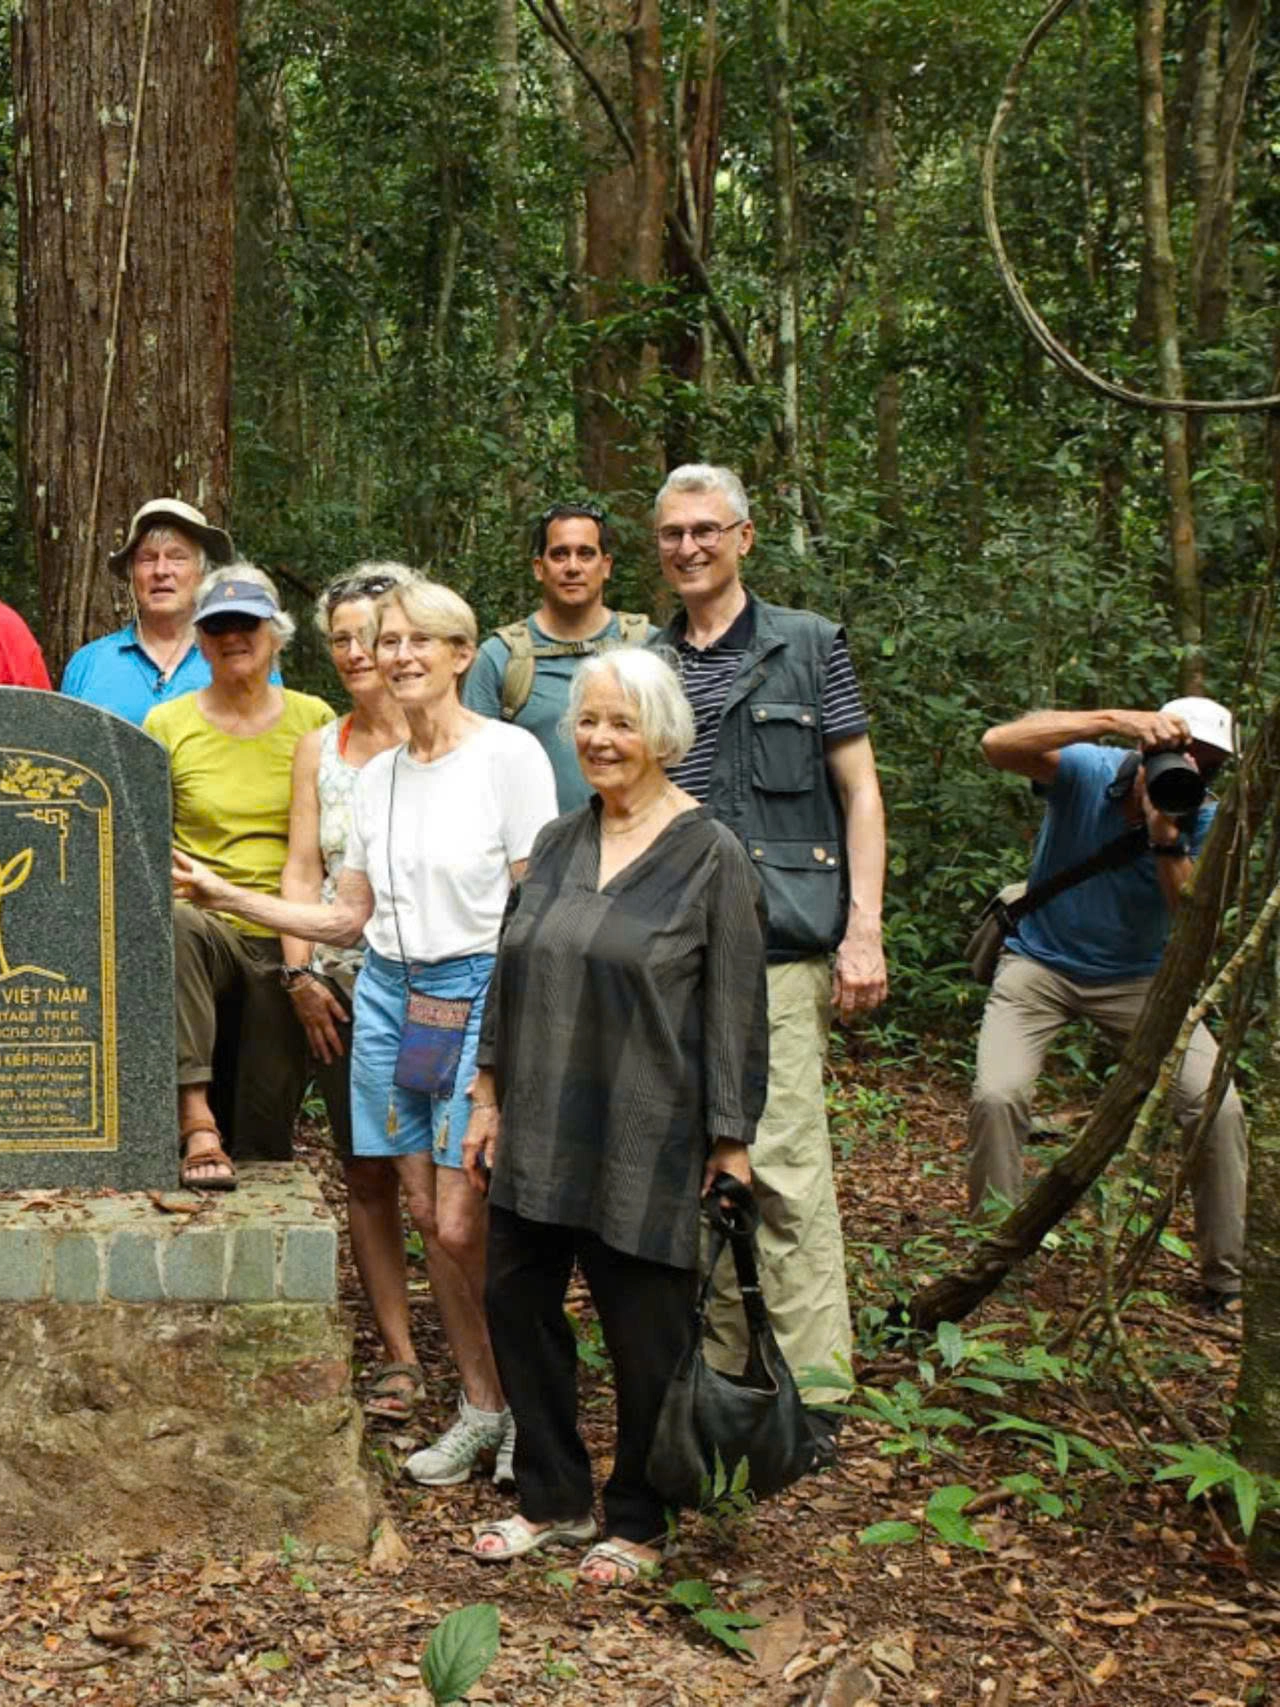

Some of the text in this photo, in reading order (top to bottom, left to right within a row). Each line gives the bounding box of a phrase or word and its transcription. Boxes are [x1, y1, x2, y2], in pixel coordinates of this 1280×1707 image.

[2, 985, 42, 1008] VIỆT
[48, 987, 89, 1004] NAM
[42, 1010, 81, 1022] TREE
